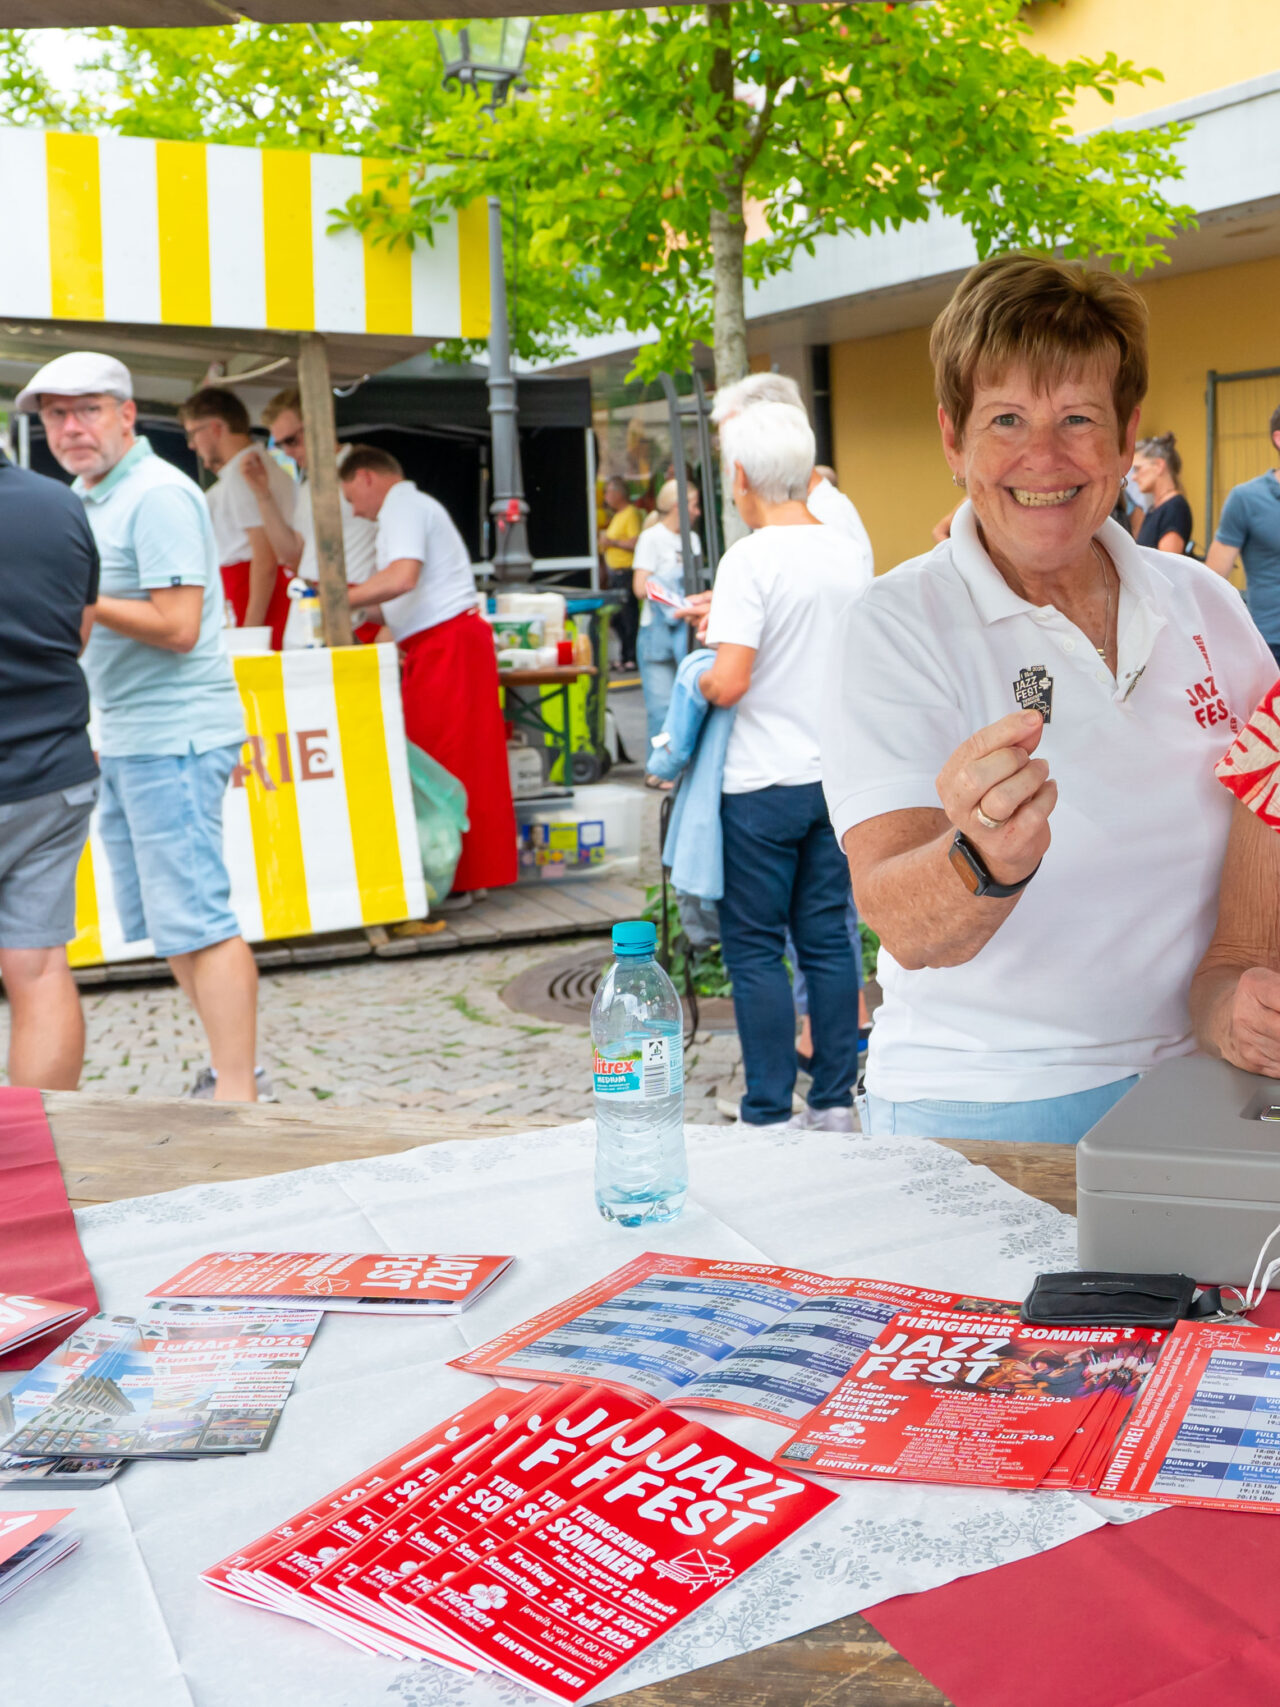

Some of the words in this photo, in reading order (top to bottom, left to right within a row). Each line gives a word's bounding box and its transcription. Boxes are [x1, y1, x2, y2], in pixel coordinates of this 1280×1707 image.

[1016, 676, 1038, 691] JAZZ
[1016, 685, 1038, 701] FEST
[709, 1262, 780, 1275] JAZZFEST
[782, 1270, 854, 1289] TIENGENER
[854, 1280, 915, 1299] SOMMER
[917, 1290, 951, 1305] 2026
[896, 1315, 1016, 1338] TIENGENER
[1018, 1328, 1118, 1343] SOMMER
[154, 1340, 238, 1352] LuftArt
[246, 1336, 306, 1346] 2026
[155, 1355, 206, 1363] Kunst
[233, 1351, 300, 1359] Tiengen
[868, 1333, 1011, 1360] JAZZ
[856, 1356, 1000, 1384] FEST
[826, 1401, 870, 1412] Musik
[873, 1407, 899, 1415] auf
[831, 1394, 890, 1407] Altstadt
[840, 1387, 909, 1401] Tiengener
[820, 1408, 831, 1416] 4
[833, 1409, 888, 1423] Bühnen
[1182, 1424, 1210, 1433] Bühne
[806, 1430, 866, 1445] Tiengen
[816, 1458, 870, 1471] EINTRITT
[871, 1464, 898, 1473] FREI
[1100, 1449, 1134, 1490] EINTRITT
[1121, 1427, 1146, 1448] FREI
[1165, 1459, 1195, 1467] Bühne
[645, 1443, 805, 1513] JAZZ
[603, 1470, 769, 1546] FEST
[569, 1505, 656, 1562] TIENGENER
[546, 1517, 645, 1581] SOMMER
[535, 1529, 549, 1541] in
[548, 1540, 570, 1554] der
[571, 1553, 628, 1590] Tiengener
[627, 1588, 678, 1615] Altstadt
[437, 1587, 496, 1629] Tiengen
[483, 1556, 541, 1597] Samstag
[548, 1598, 572, 1616] 25.
[571, 1613, 602, 1632] Juli
[597, 1626, 637, 1650] 2026
[508, 1551, 557, 1587] Freitag
[563, 1587, 587, 1606] 24.
[586, 1601, 617, 1620] Juli
[612, 1613, 651, 1638] 2026
[492, 1632, 554, 1671] EINTRITT
[552, 1667, 586, 1688] FREI
[540, 1631, 554, 1642] bis
[555, 1639, 608, 1671] Mitternacht
